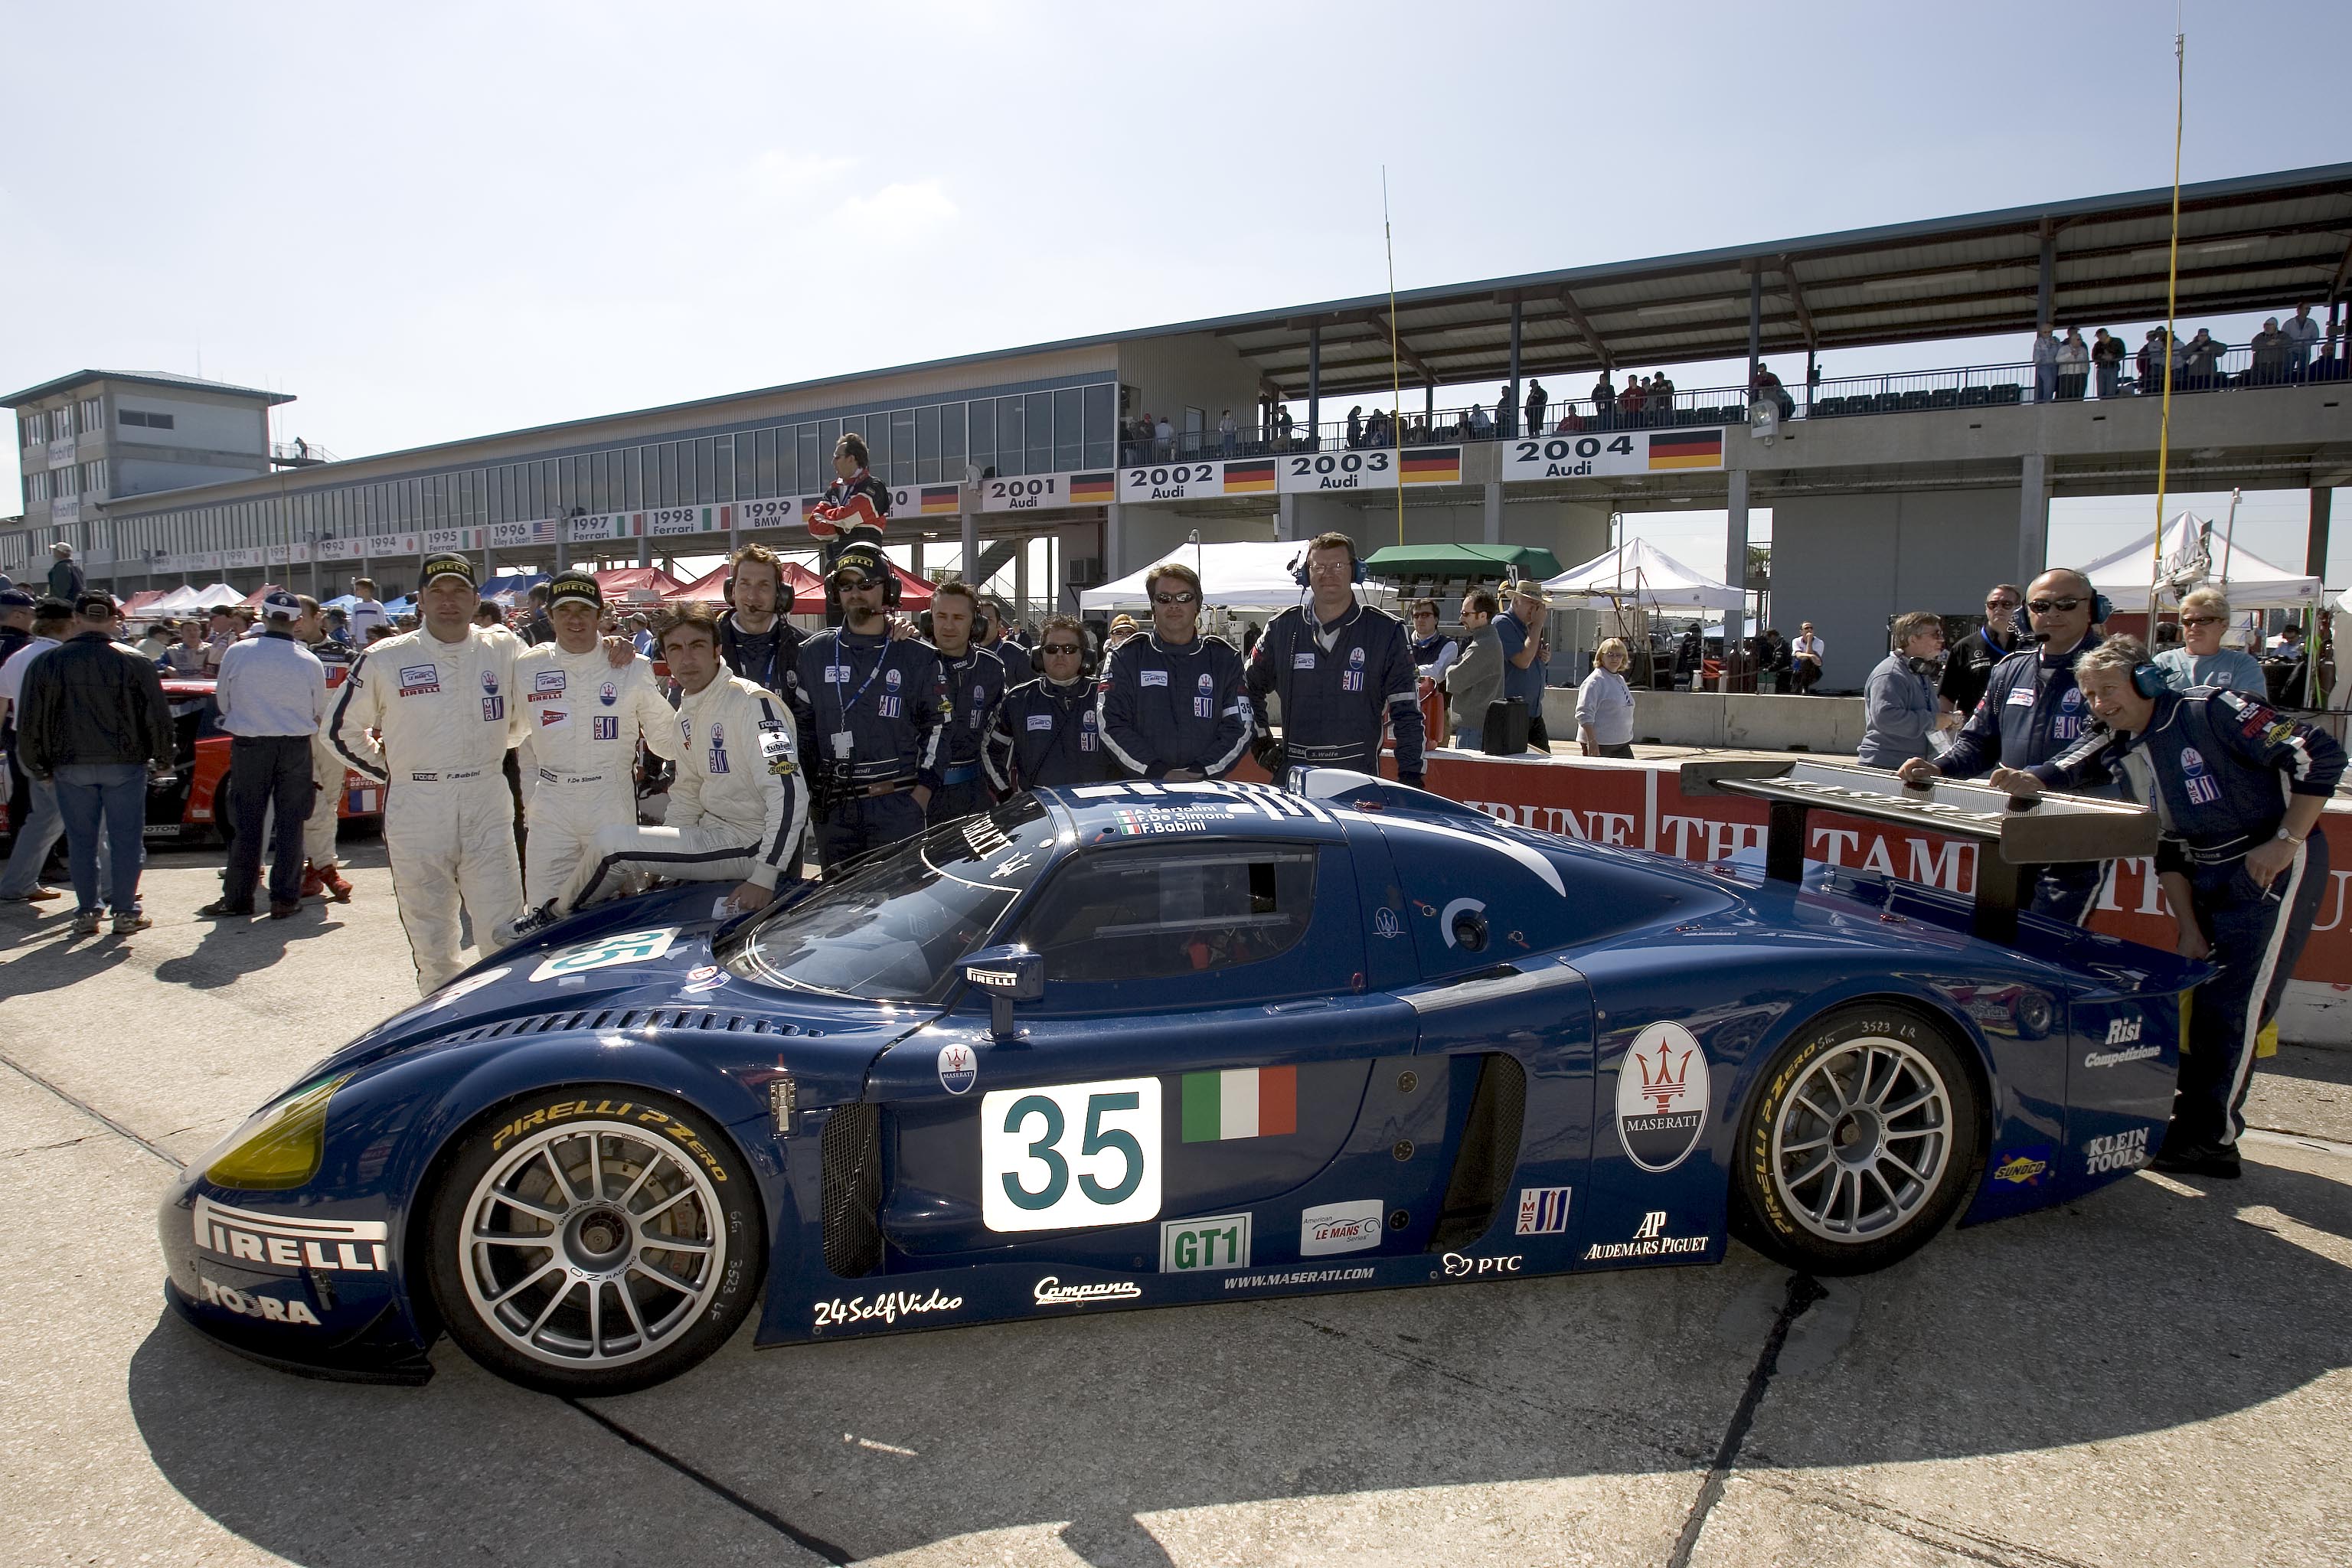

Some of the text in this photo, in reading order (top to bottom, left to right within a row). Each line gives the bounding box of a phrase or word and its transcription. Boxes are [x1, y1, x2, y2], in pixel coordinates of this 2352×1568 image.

[1517, 436, 1634, 462] 2004
[1292, 452, 1389, 476] 2003
[1546, 460, 1592, 477] Audi
[1130, 464, 1213, 488] 2002
[1320, 474, 1358, 489] Audi
[991, 479, 1054, 498] 2001
[1152, 485, 1184, 499] Audi
[744, 501, 791, 518] 1999
[1009, 495, 1037, 509] Audi
[573, 516, 609, 531] 1997
[654, 508, 694, 525] 1998
[754, 516, 781, 528] BMW
[494, 524, 526, 537] 1996
[573, 530, 609, 541] Ferrari
[653, 523, 694, 534] Ferrari
[322, 541, 345, 551] 1993
[371, 537, 396, 548] 1994
[429, 531, 457, 544] 1995
[494, 537, 508, 546] Riley
[516, 537, 531, 545] Scott
[227, 550, 247, 560] 1991
[429, 543, 457, 552] Ferrari
[426, 560, 470, 574] PIRELLI
[838, 555, 874, 568] PIRELLI
[1505, 564, 1519, 587] 37
[553, 580, 596, 596] PIRELLI
[399, 684, 441, 697] PIRELLI
[528, 691, 562, 702] PIRELLI
[1240, 702, 1253, 714] 35
[2266, 719, 2296, 747] SUNOCO
[446, 769, 481, 779] F.Babini
[2188, 781, 2200, 803] IMSA
[1134, 805, 1217, 815] A.Bertolini
[1746, 776, 2004, 831] MASERA
[1136, 811, 1236, 823] F.De Simone
[1142, 820, 1207, 835] F.Babini
[1812, 828, 1980, 898] TAM
[551, 932, 665, 971] 35
[966, 967, 1018, 987] PIRELLI
[1861, 1020, 1891, 1034] 3523
[2105, 1015, 2142, 1053] Risi
[2084, 1044, 2161, 1068] Competizione
[942, 1071, 974, 1080] MASERATI
[1771, 1042, 1816, 1102] ZERO
[1762, 1098, 1787, 1123] P
[1626, 1115, 1697, 1132] MASERATI
[492, 1099, 728, 1181] PIRELLI P ZERO
[2088, 1127, 2149, 1158] KLEIN
[1001, 1092, 1144, 1210] 35
[2086, 1147, 2145, 1175] TOOLS
[1995, 1161, 2045, 1179] SUNOCO
[1756, 1129, 1794, 1234] PIRELLI
[1303, 1216, 1332, 1225] American
[1519, 1191, 1537, 1233] IMSA
[194, 1194, 388, 1272] PIRELLI
[1315, 1225, 1359, 1240] LE MANS
[1632, 1211, 1667, 1239] AP
[1346, 1234, 1367, 1243] Series
[1174, 1226, 1238, 1270] GT1
[1584, 1236, 1709, 1260] AUDEMARS PIGUET
[606, 1256, 637, 1279] RACING
[1478, 1255, 1522, 1274] PTC
[724, 1259, 743, 1293] 3523
[1224, 1267, 1375, 1289] WWW.MASERATI.COM
